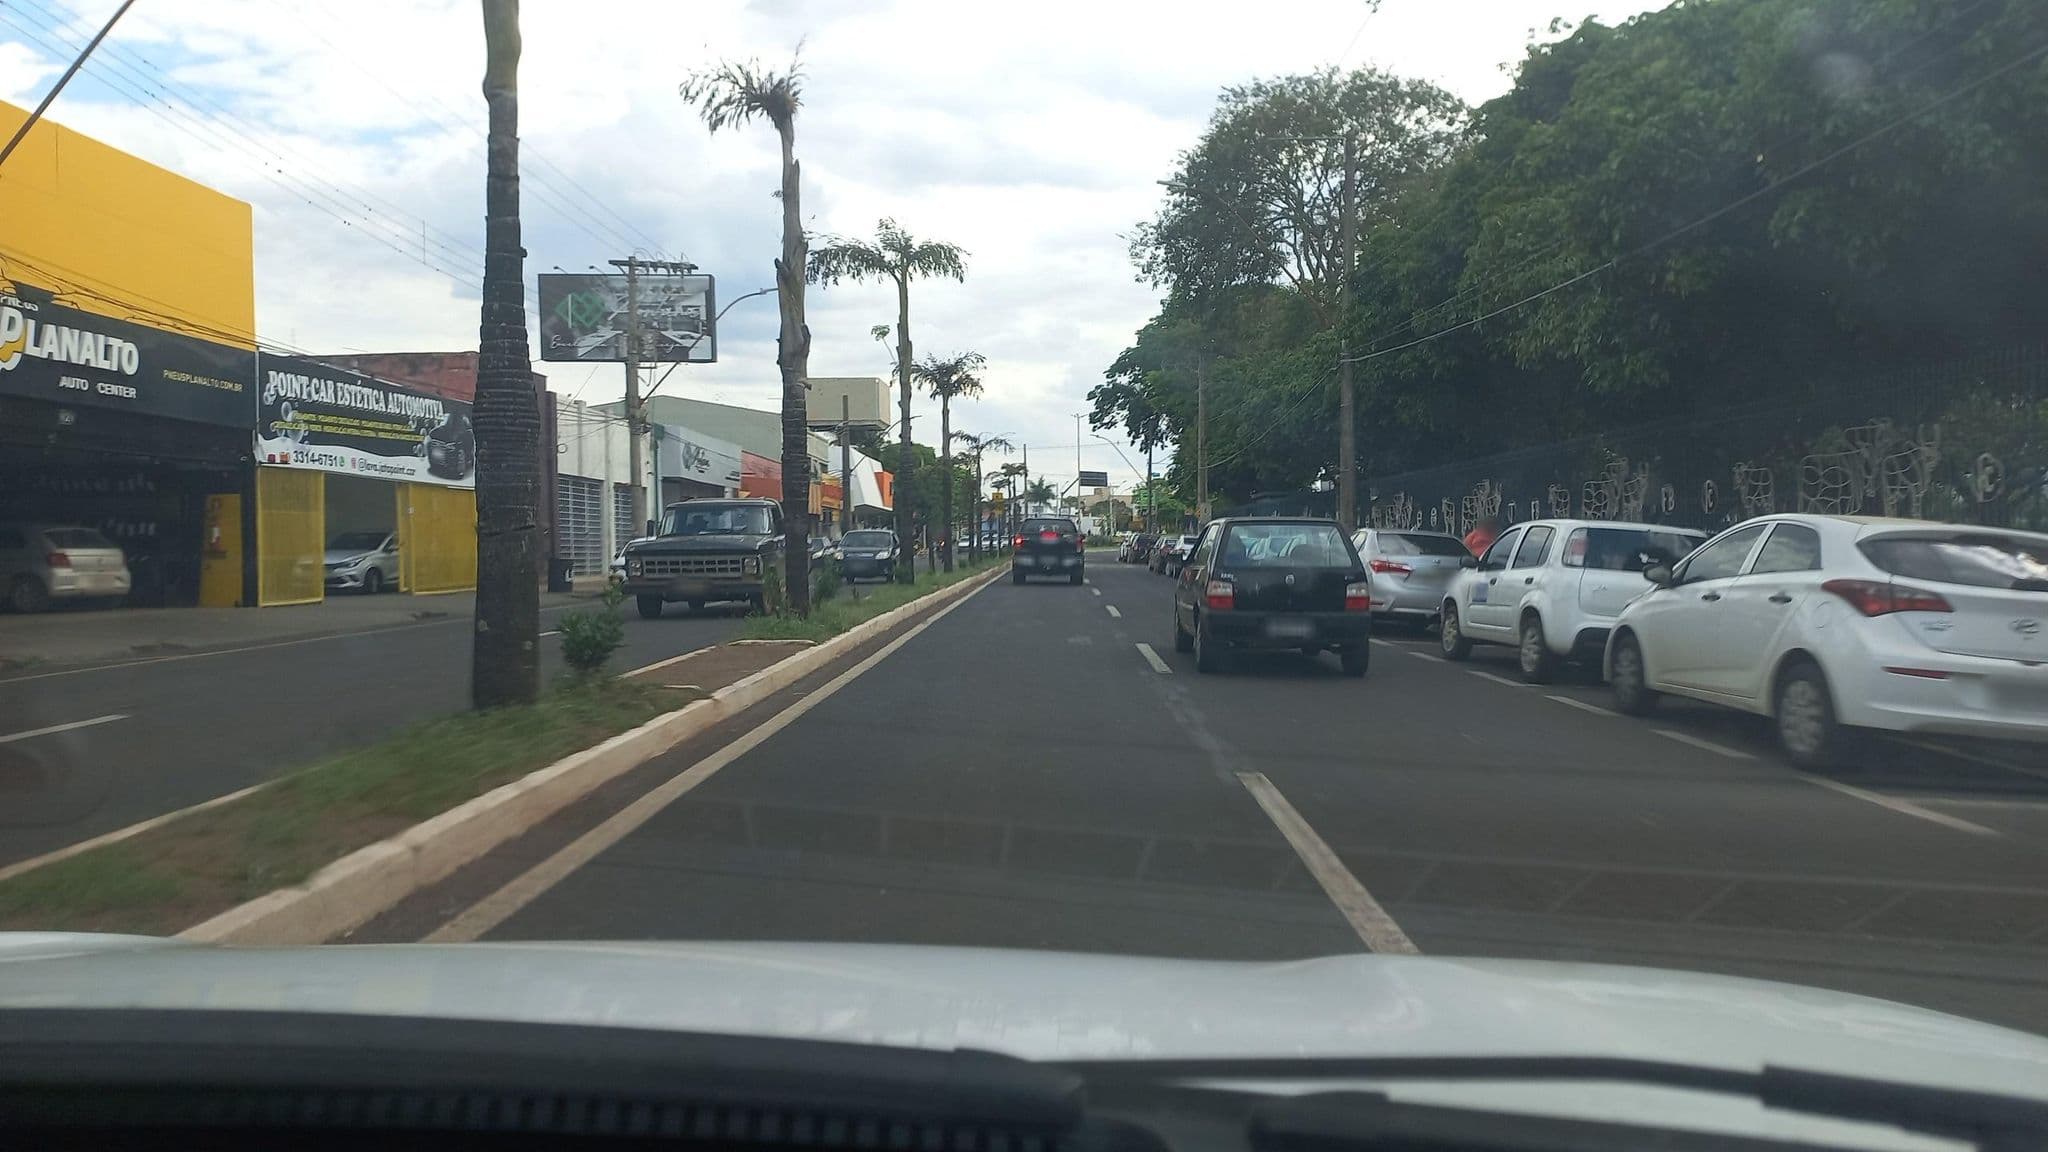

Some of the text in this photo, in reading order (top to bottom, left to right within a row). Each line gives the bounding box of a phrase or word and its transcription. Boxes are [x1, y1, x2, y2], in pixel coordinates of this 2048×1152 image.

[0, 306, 139, 376] PLANALTO
[58, 375, 137, 399] AUTO CENTER
[335, 379, 386, 412] ESTÉTICA
[386, 391, 444, 419] AUTOMOTIVA
[292, 450, 338, 467] 3314-6751
